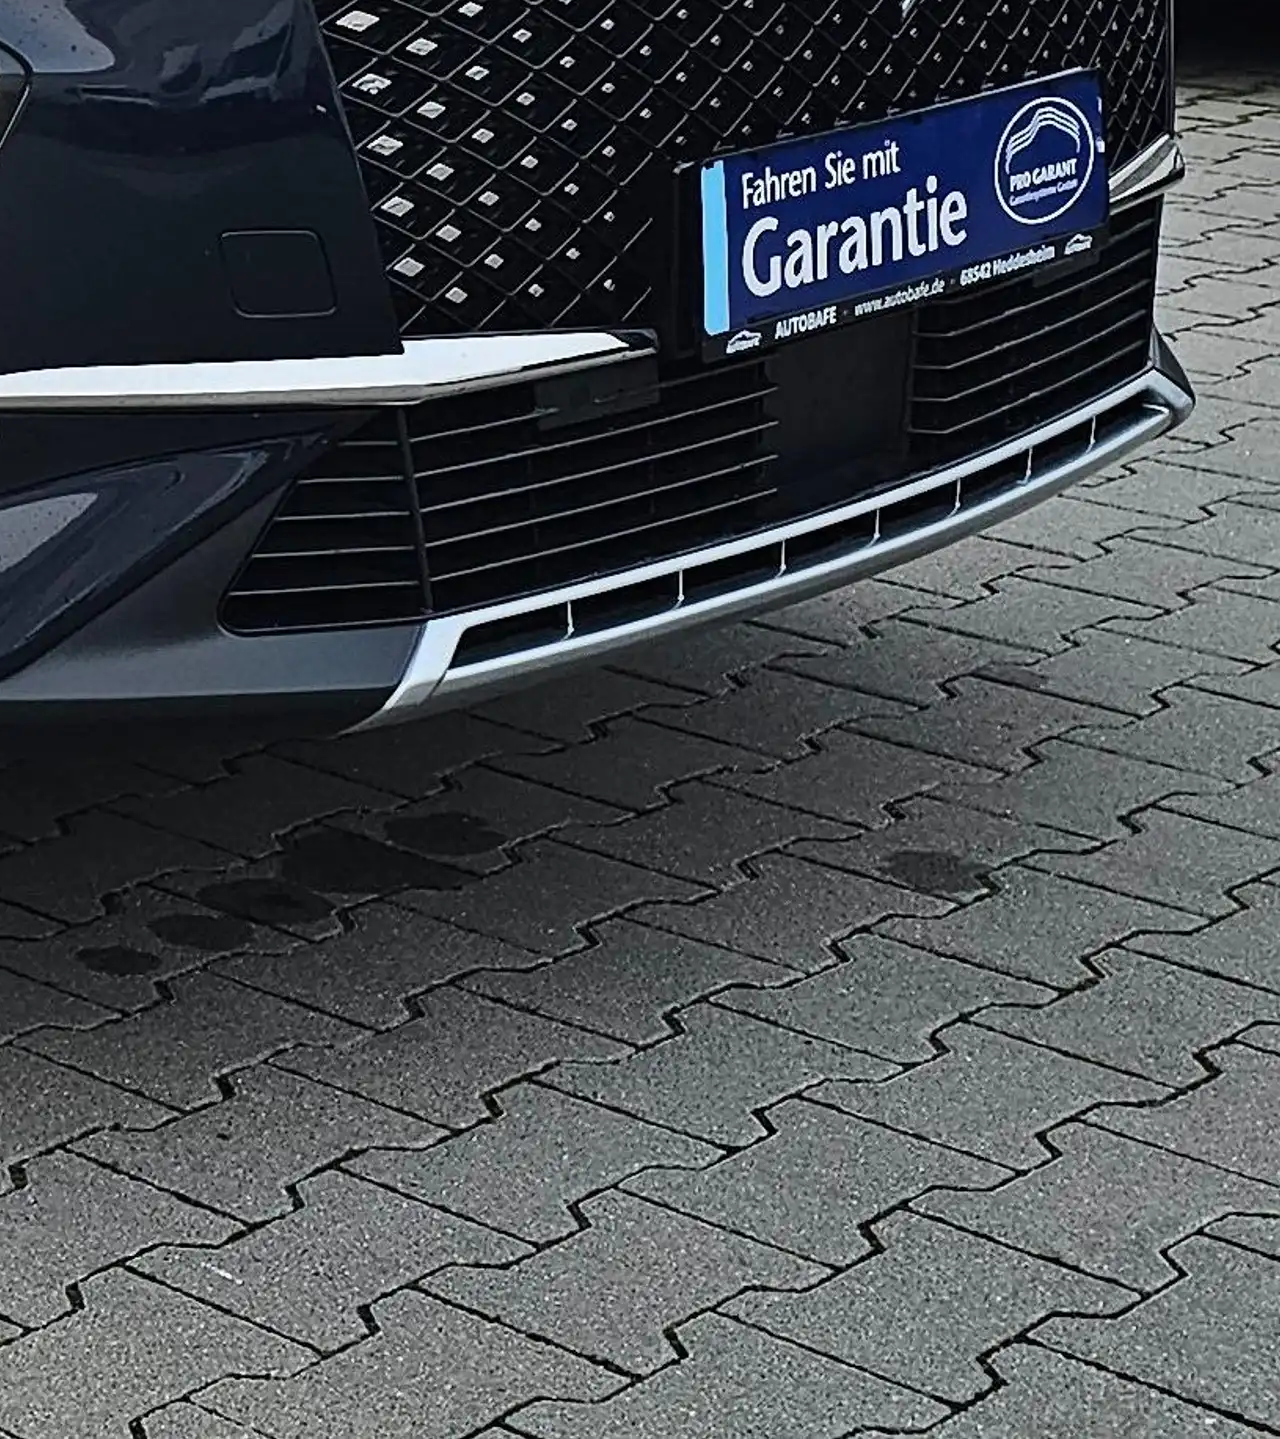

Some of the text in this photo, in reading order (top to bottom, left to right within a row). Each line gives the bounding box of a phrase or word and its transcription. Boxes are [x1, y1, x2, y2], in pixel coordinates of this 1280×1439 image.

[742, 140, 901, 209] Fahren Sie mit
[1010, 171, 1031, 192] PRO
[1032, 158, 1077, 185] GARANT
[742, 175, 968, 297] Garantie
[775, 306, 837, 339] AUTOBAFE
[854, 277, 945, 316] www.autobafe.de
